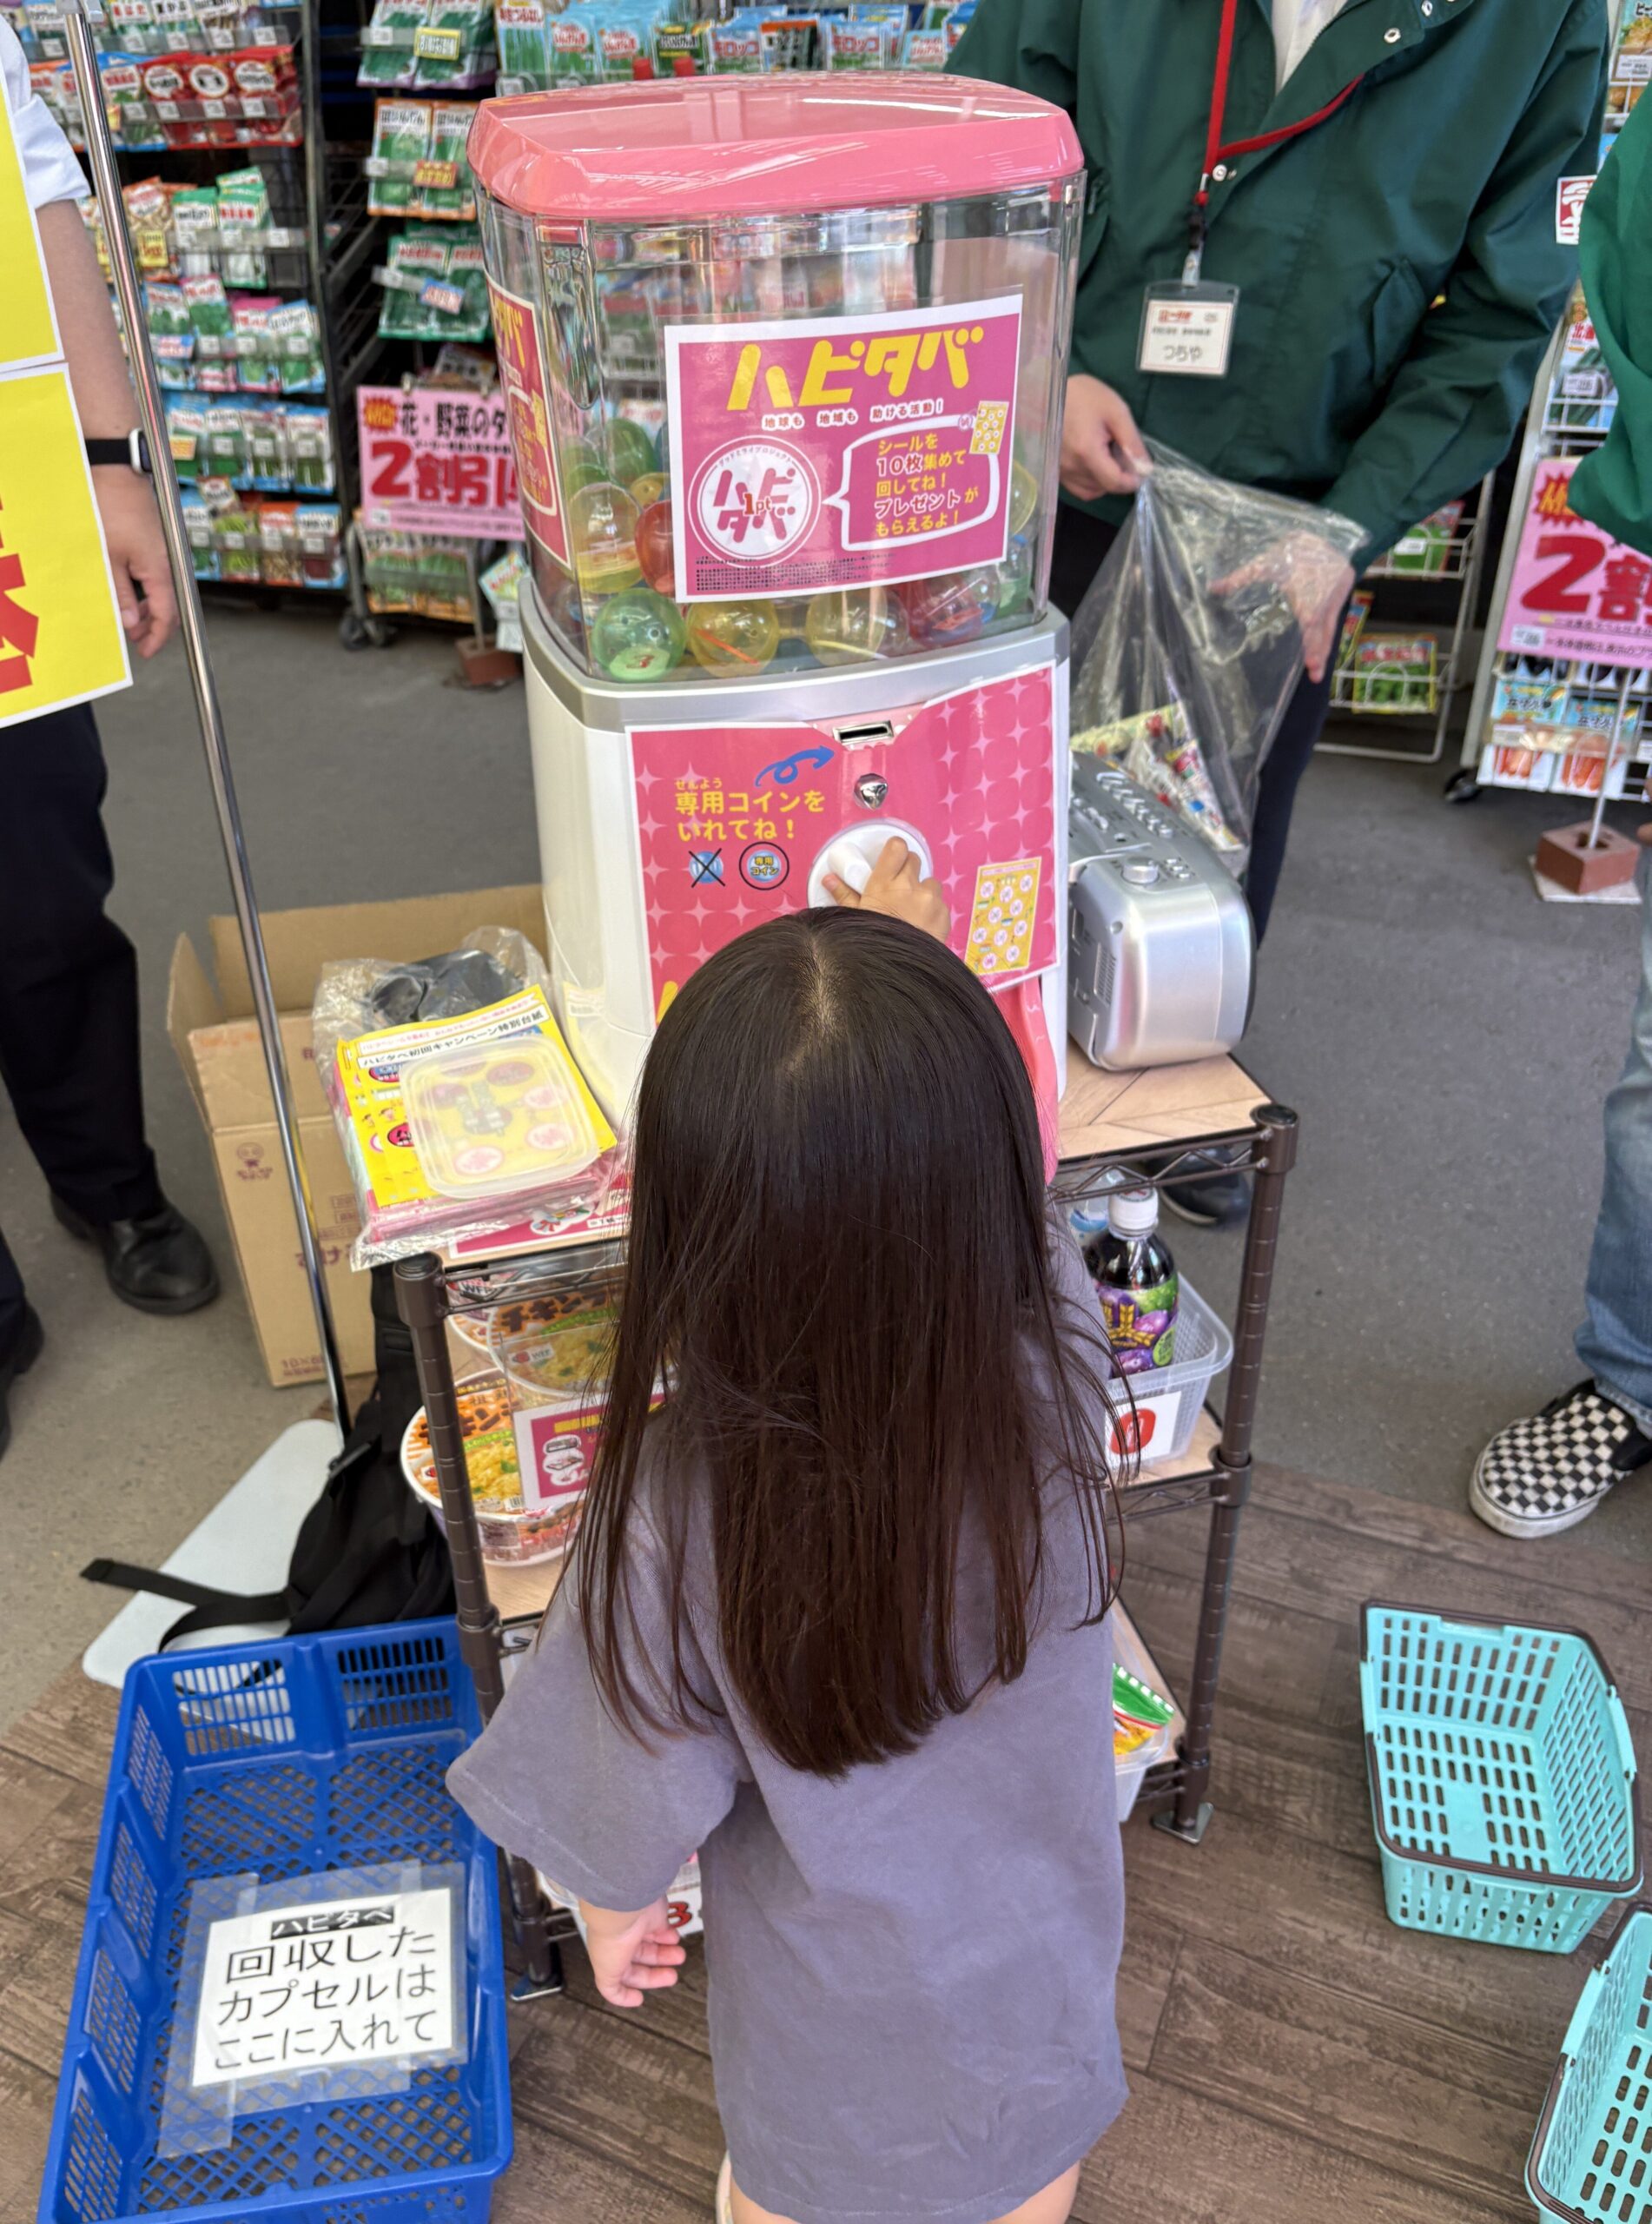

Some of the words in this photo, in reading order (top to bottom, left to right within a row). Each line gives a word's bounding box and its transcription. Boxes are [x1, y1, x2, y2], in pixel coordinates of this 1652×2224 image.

[763, 414, 804, 429] 地球も
[817, 411, 858, 427] 地域も
[870, 398, 943, 421] 助ける活動！
[878, 433, 938, 455] シールを
[876, 449, 967, 477] 10枚集めて
[876, 473, 946, 498] 回してね！
[876, 510, 959, 537] もらえるよ！
[675, 778, 723, 790] せんよう
[675, 790, 825, 816] 専用コインを
[677, 817, 794, 842] いれてね！
[750, 866, 779, 877] コイン
[754, 856, 775, 865] 専用
[226, 1925, 437, 1984] 回収した
[217, 1963, 437, 2026] カプセルは
[215, 2009, 437, 2070] ここに入れて
